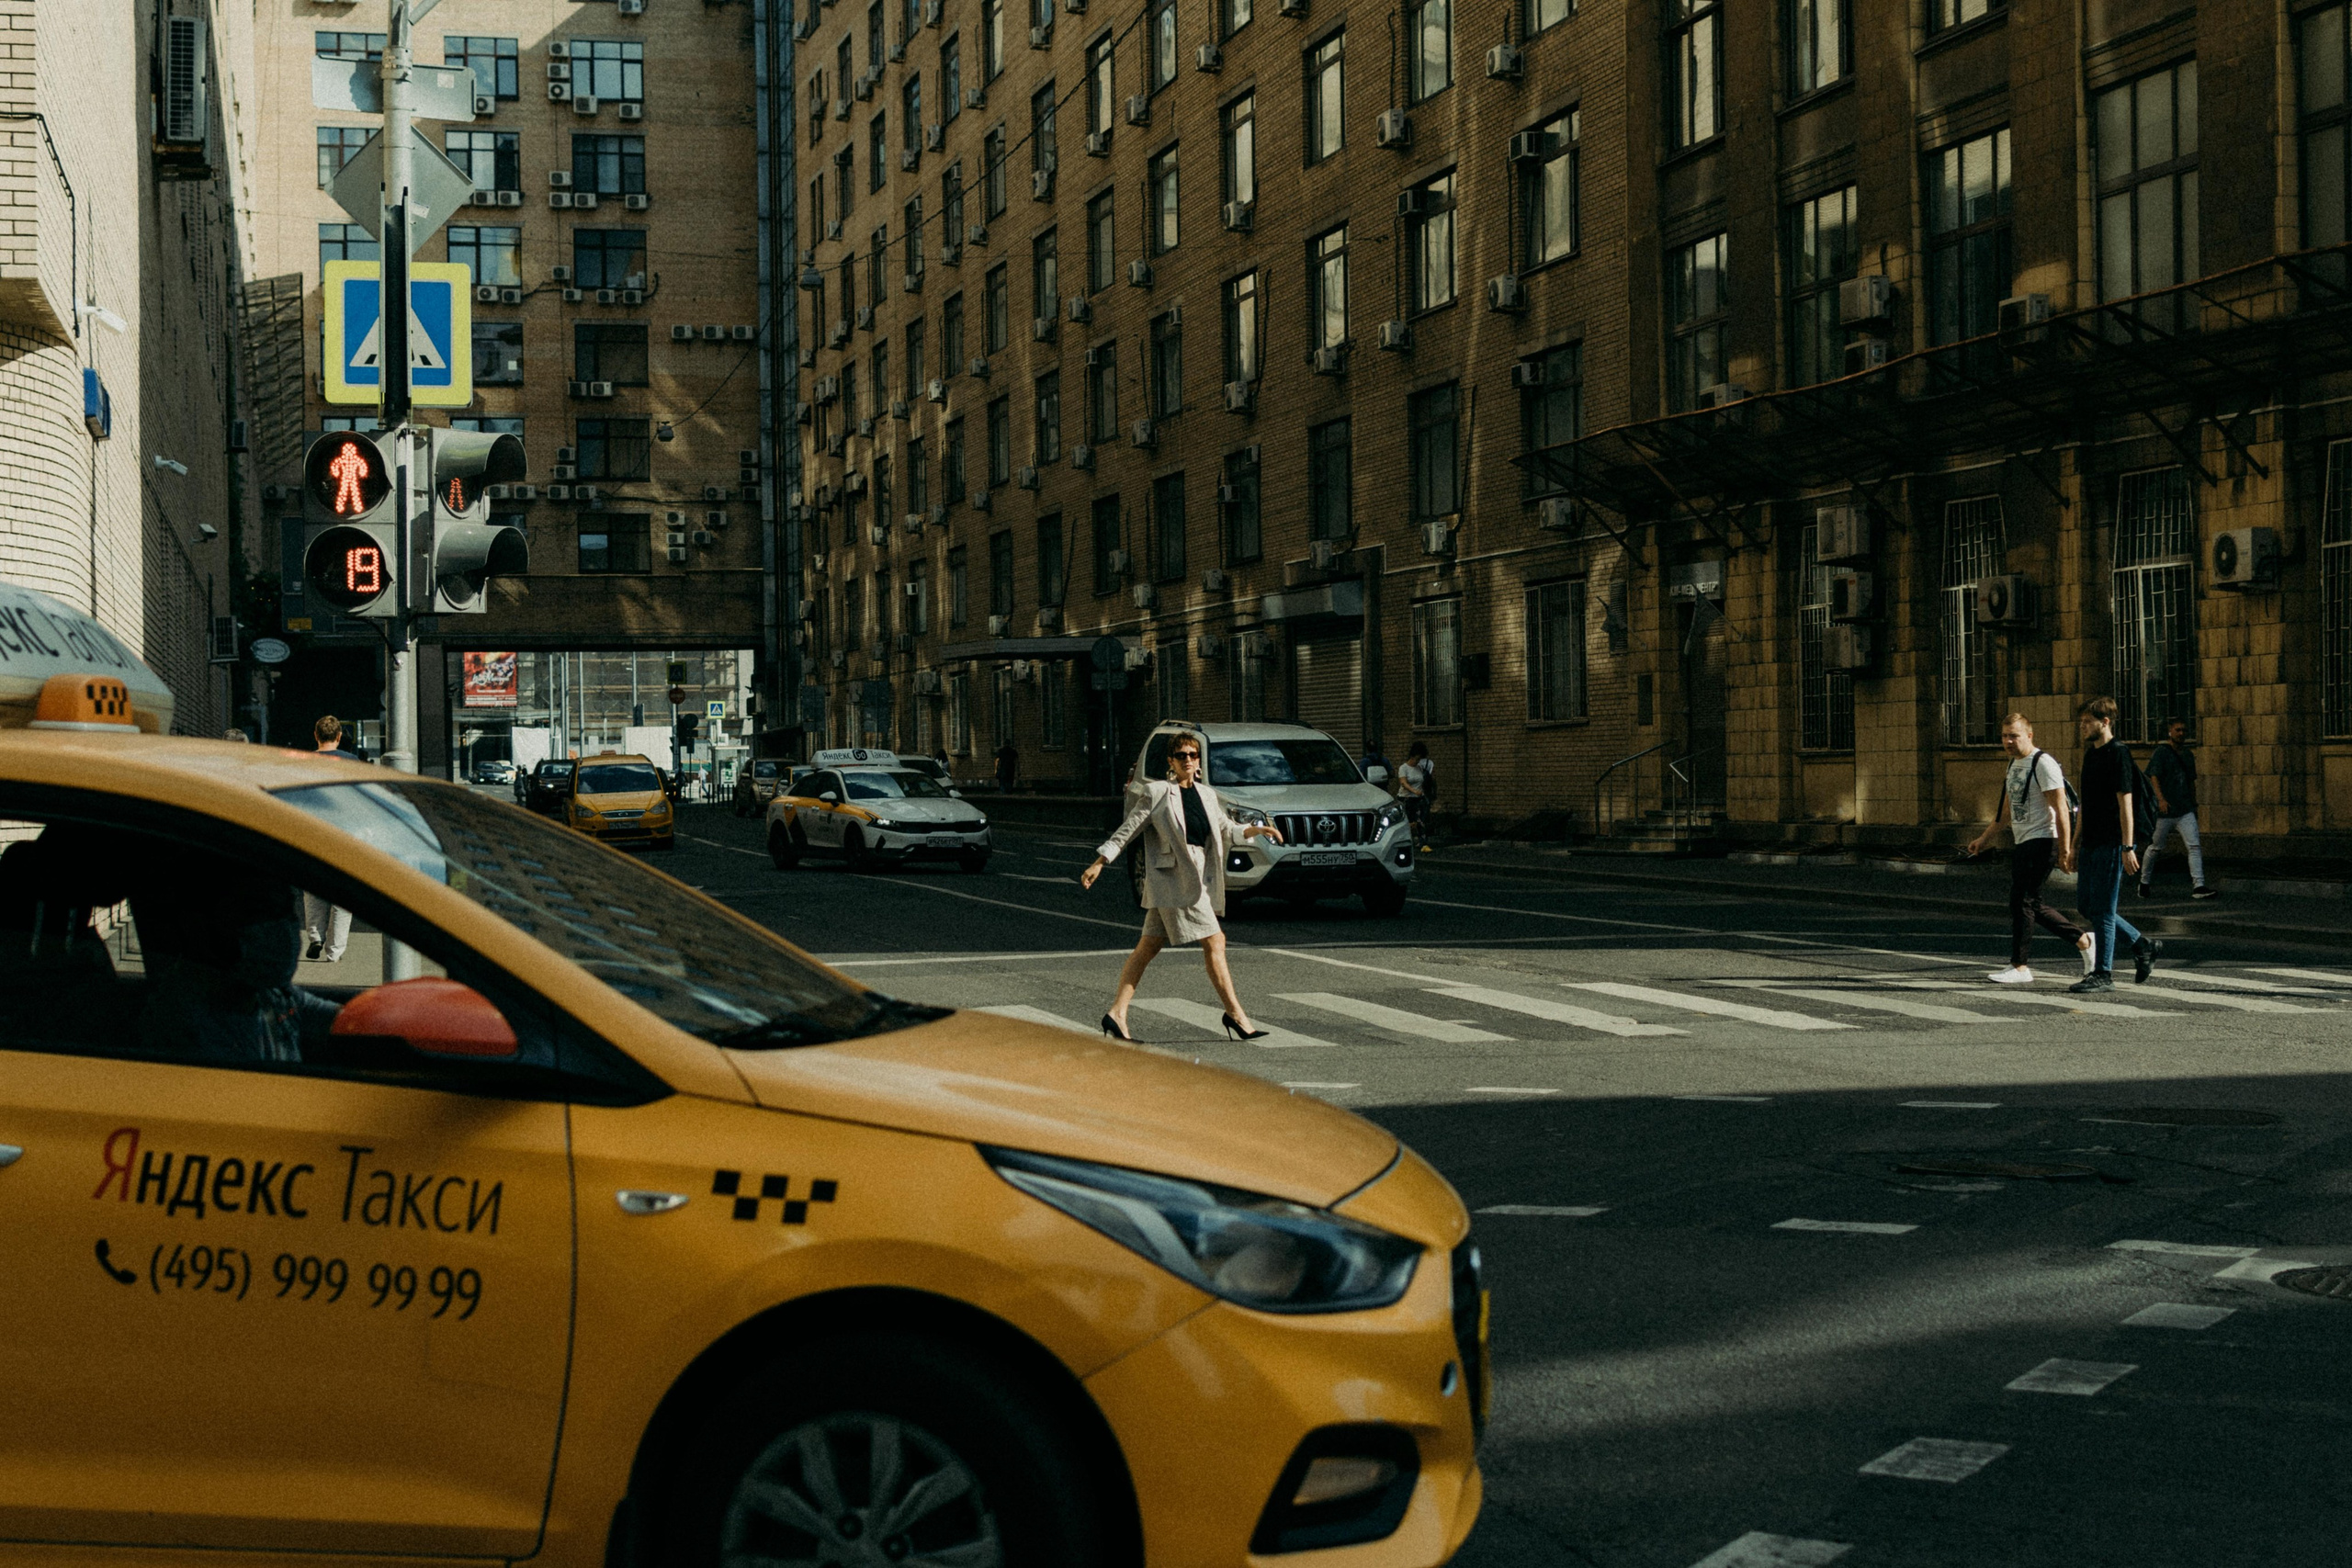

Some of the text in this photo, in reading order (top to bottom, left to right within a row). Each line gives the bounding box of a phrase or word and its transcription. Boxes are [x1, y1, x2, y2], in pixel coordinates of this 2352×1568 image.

[346, 547, 380, 592] 19
[821, 750, 852, 761] Яндекс
[868, 750, 892, 759] Такси
[93, 1127, 503, 1235] Яндекс Такси
[150, 1244, 483, 1321] (495) 999 99 99
